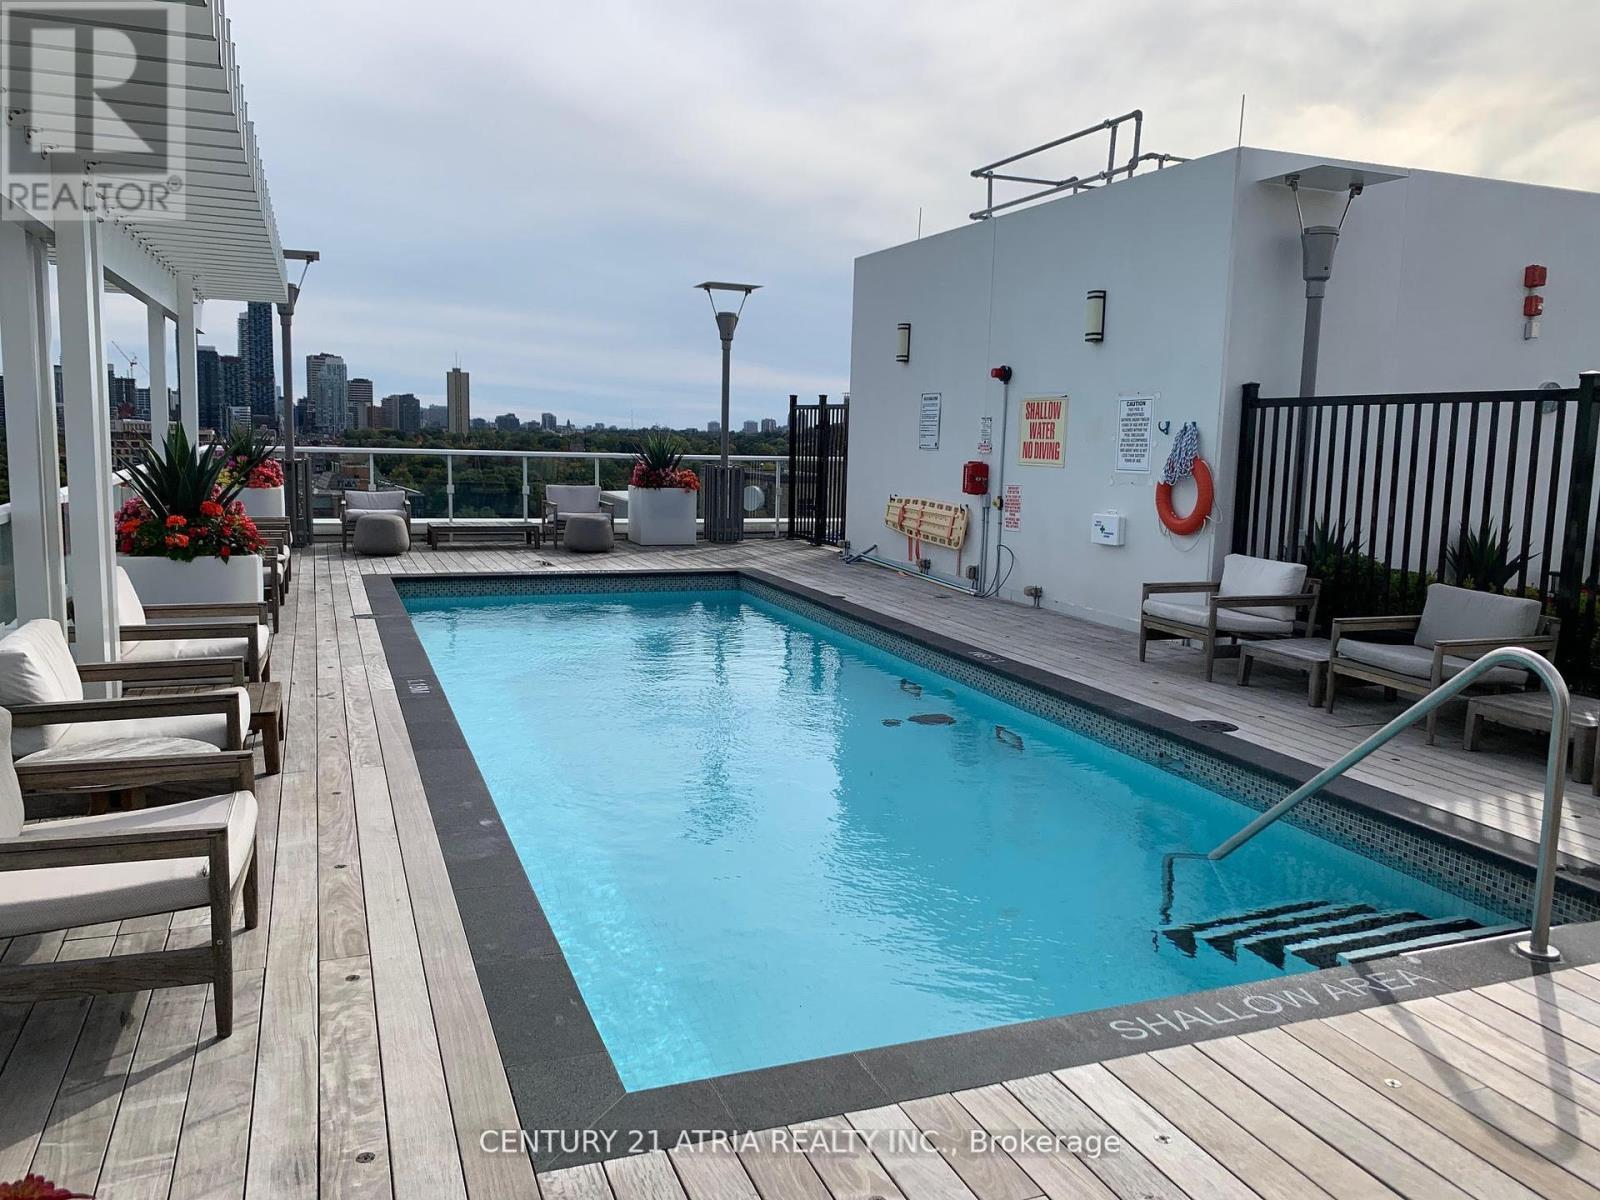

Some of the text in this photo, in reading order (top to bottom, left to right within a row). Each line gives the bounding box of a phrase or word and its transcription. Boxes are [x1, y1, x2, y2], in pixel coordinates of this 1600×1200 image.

[1025, 401, 1062, 420] SHALLOW
[1029, 421, 1056, 440] WATER
[1022, 441, 1061, 460] NO DIVING
[1109, 969, 1437, 1040] SHALLOW AREA
